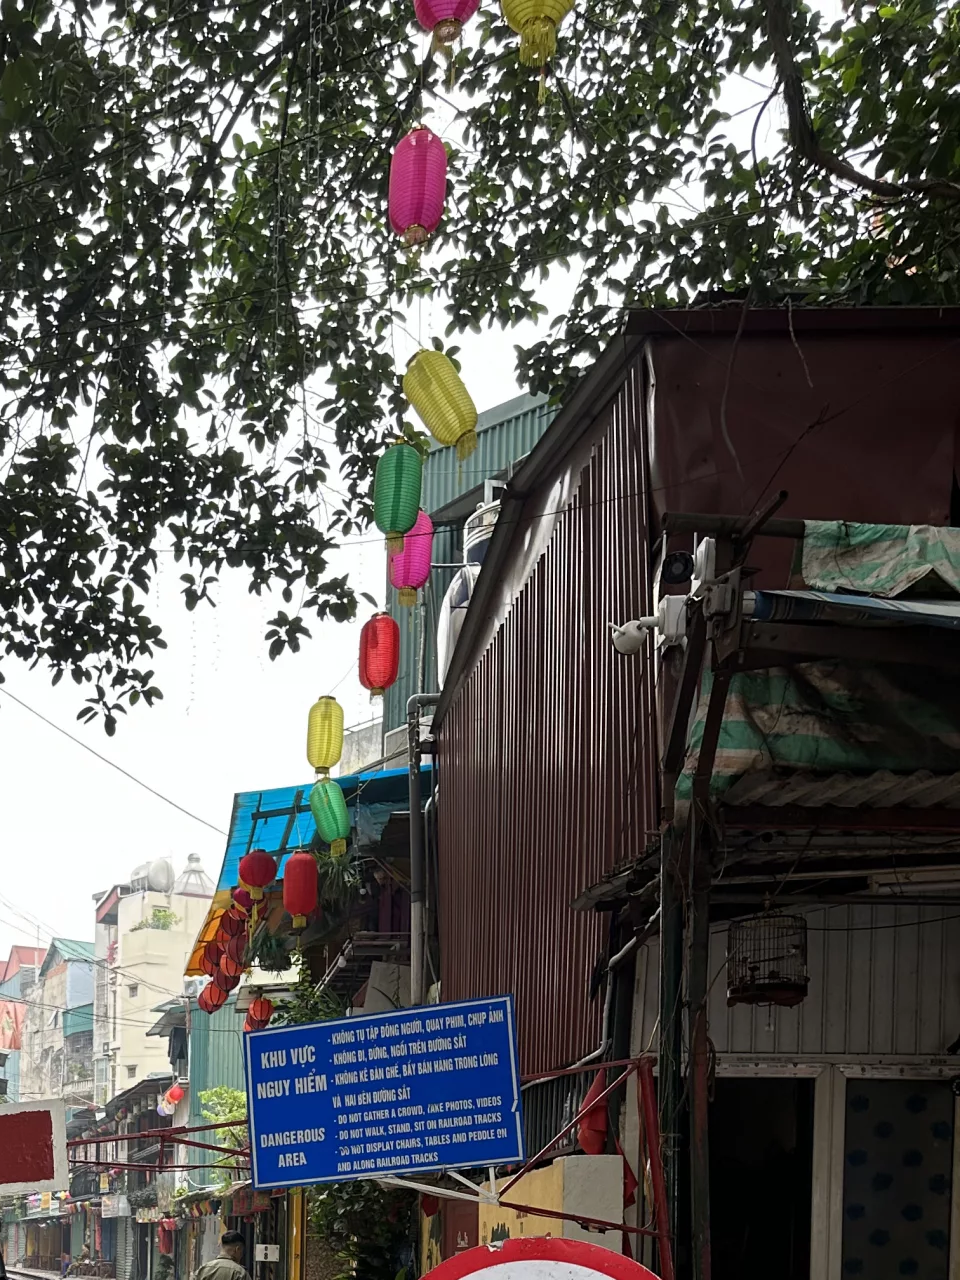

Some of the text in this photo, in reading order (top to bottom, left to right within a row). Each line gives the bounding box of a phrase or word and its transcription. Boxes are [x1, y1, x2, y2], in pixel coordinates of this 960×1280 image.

[260, 1044, 315, 1069] KHU VỰC
[256, 1067, 327, 1099] NGUY HIỂM
[260, 1127, 325, 1148] DANGEROUS
[277, 1151, 307, 1167] AREA
